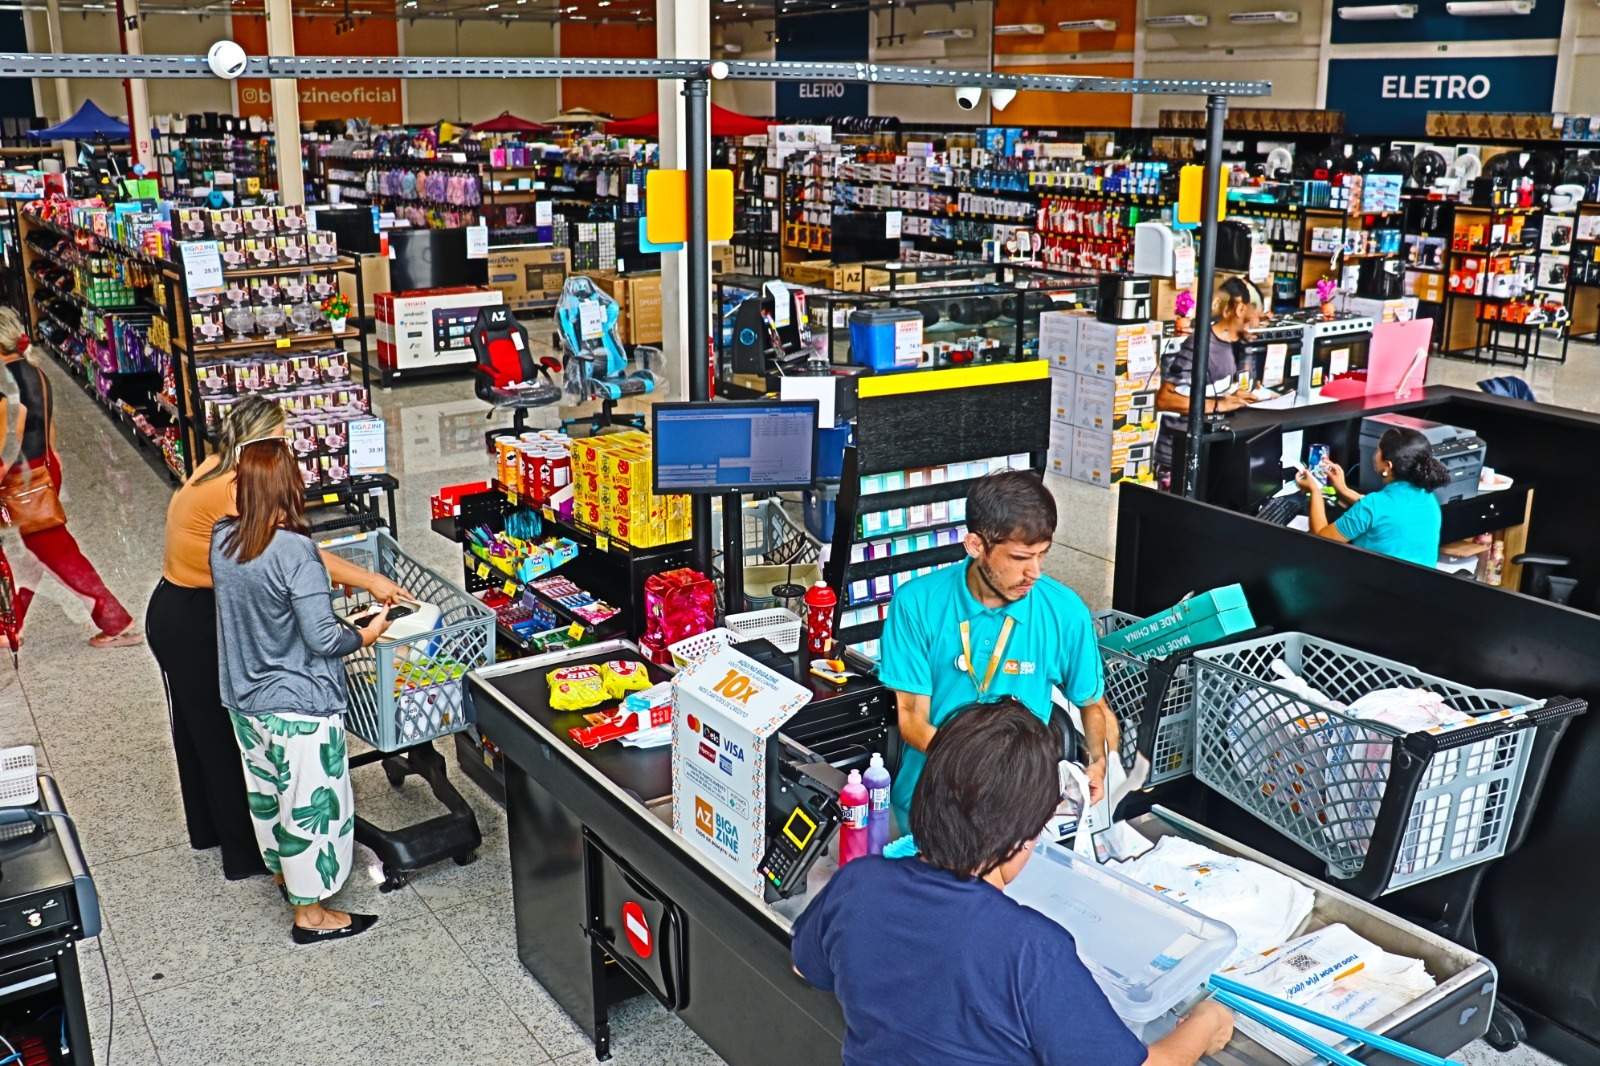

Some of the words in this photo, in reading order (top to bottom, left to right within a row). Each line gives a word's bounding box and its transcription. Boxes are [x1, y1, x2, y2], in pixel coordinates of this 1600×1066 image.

[799, 83, 844, 97] ELETRO
[1382, 75, 1490, 99] ELETRO
[786, 267, 795, 277] AZ
[847, 272, 860, 282] AZ
[573, 281, 586, 291] AZ
[491, 311, 506, 322] AZ
[1150, 622, 1159, 633] IN
[1159, 612, 1183, 629] MADE
[1124, 626, 1150, 643] CHINA
[1156, 644, 1167, 655] IN
[1166, 634, 1191, 651] MADE
[698, 686, 708, 694] NOS
[723, 700, 731, 708] DE
[723, 735, 745, 763] VISA
[697, 806, 712, 828] AZ
[716, 812, 739, 841] BIGA
[716, 826, 738, 854] ZINE
[1342, 954, 1359, 965] TUDO
[1320, 967, 1334, 978] BOM
